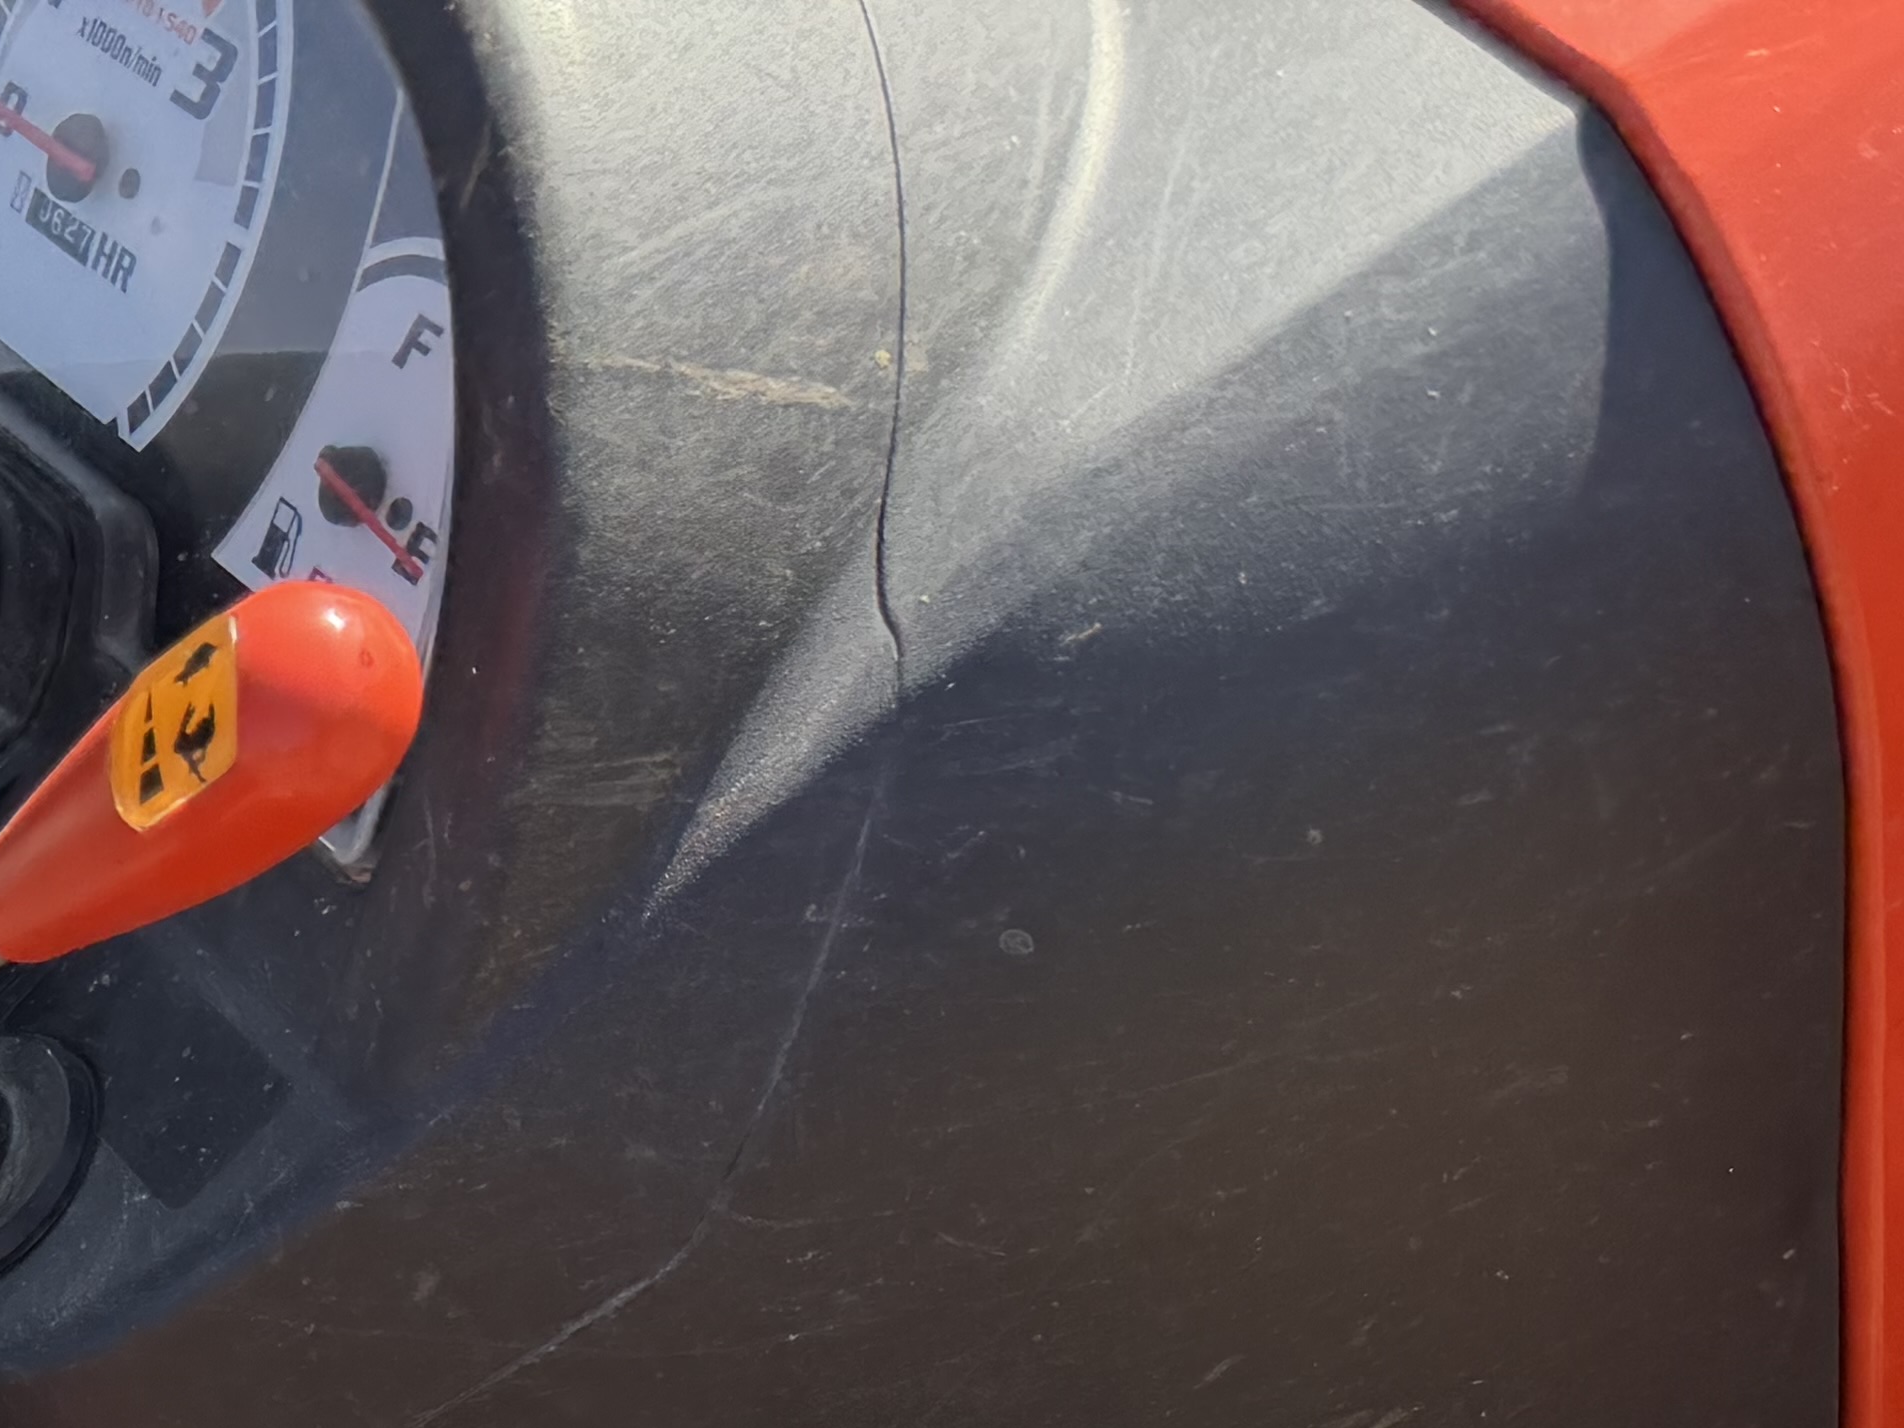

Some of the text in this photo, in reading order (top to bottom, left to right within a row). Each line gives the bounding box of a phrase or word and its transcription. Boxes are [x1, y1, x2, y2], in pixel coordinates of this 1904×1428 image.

[78, 16, 163, 88] x1000n/min
[170, 27, 239, 120] 3
[91, 232, 137, 293] HR
[390, 311, 446, 371] F
[391, 522, 437, 586] E
